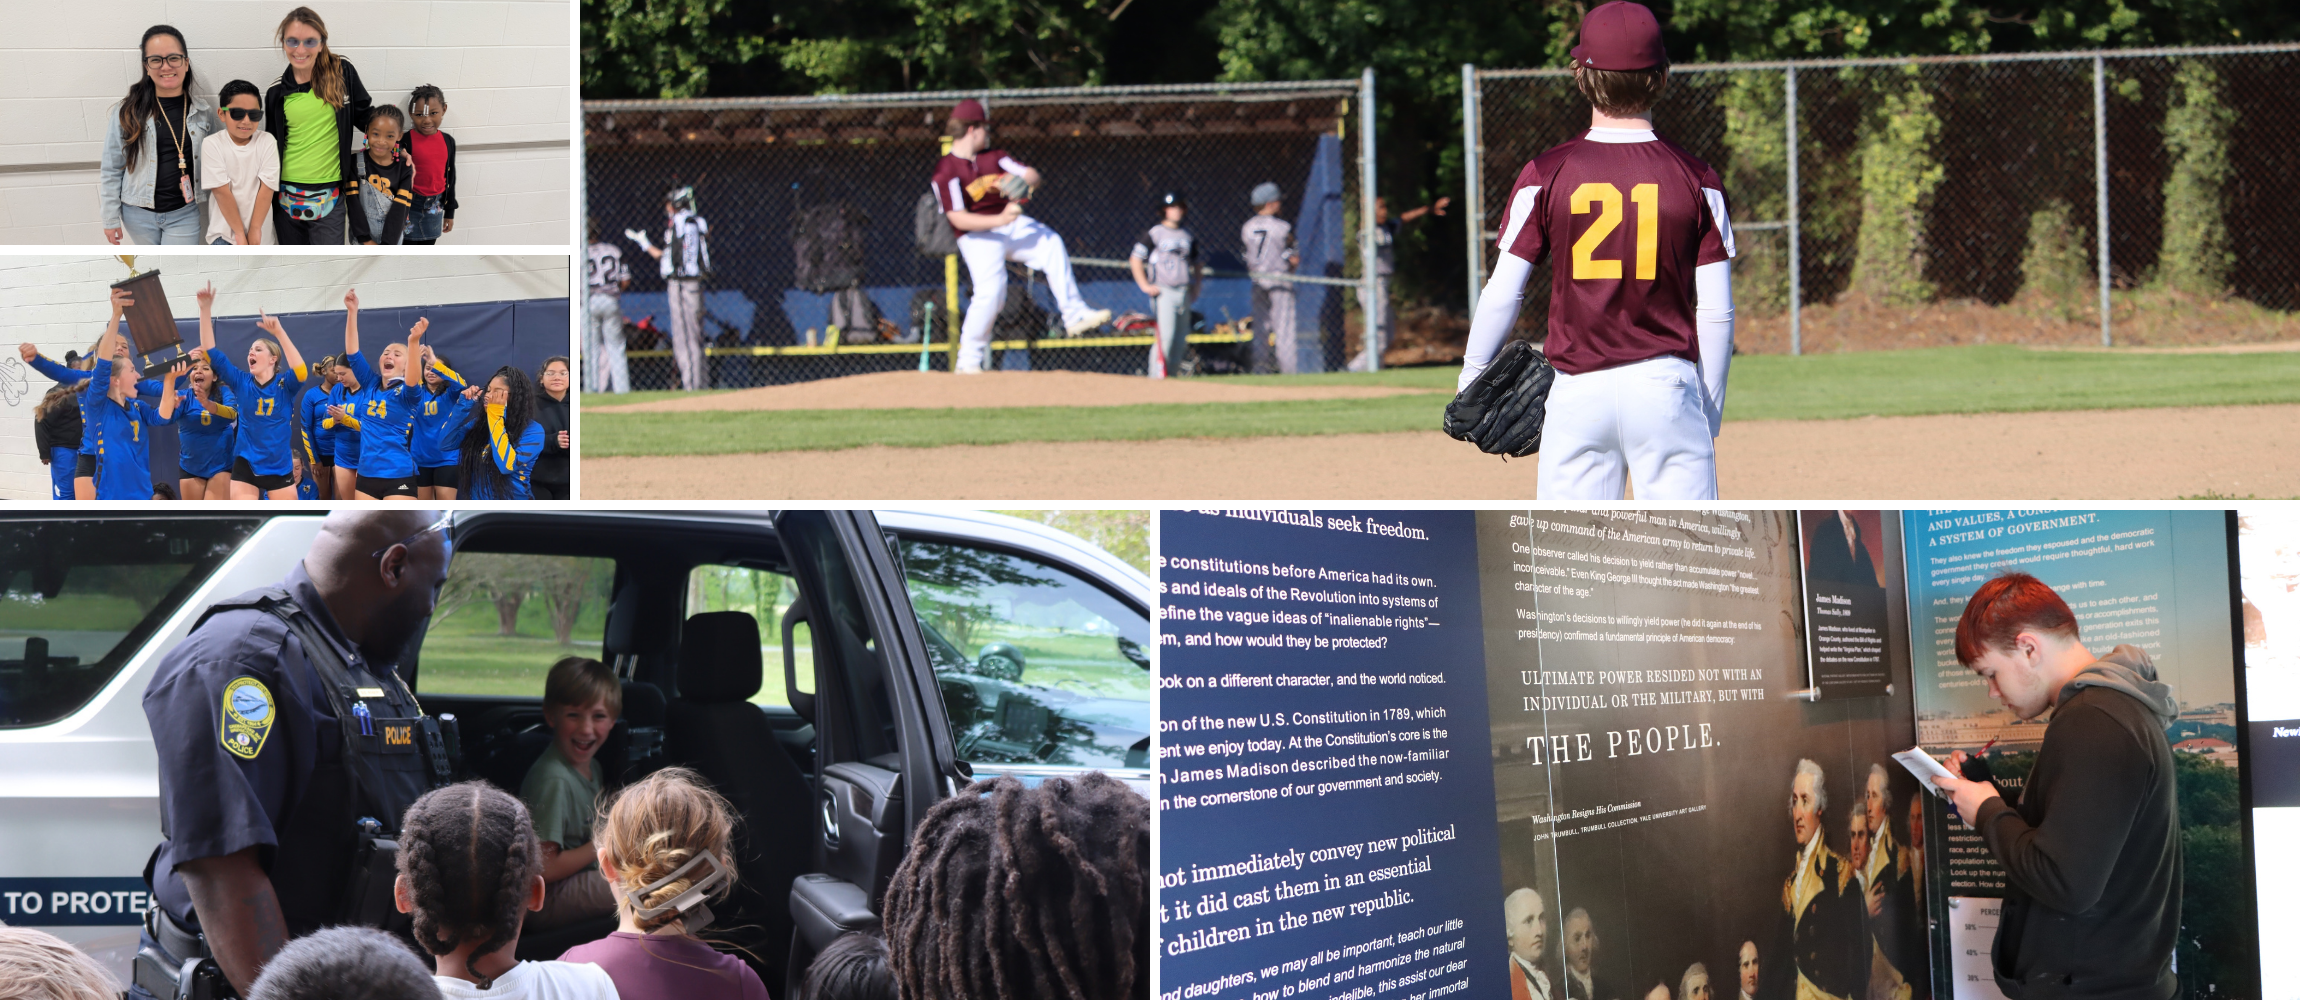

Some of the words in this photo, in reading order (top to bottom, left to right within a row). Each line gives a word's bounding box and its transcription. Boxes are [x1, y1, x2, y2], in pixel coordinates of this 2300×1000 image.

[1570, 183, 1658, 280] 21
[1253, 230, 1268, 260] 7
[255, 397, 275, 416] 17
[367, 399, 387, 419] 24
[424, 401, 438, 416] 10
[130, 420, 140, 442] 7
[1328, 515, 1363, 533] seek
[1366, 517, 1429, 540] freedom.
[1928, 519, 1952, 532] AND
[1954, 511, 2004, 528] VALUES,
[2007, 510, 2015, 519] A
[1929, 537, 1937, 547] A
[1939, 530, 1985, 545] SYSTEM
[1988, 526, 2004, 538] OF
[2007, 512, 2100, 535] GOVERNMENT.
[1930, 557, 1947, 565] They
[1948, 555, 1963, 563] also
[1963, 552, 1982, 560] knew
[1982, 550, 1994, 558] the
[1995, 546, 2025, 556] freedom
[2026, 544, 2042, 552] they
[2043, 538, 2080, 550] espoused
[2080, 535, 2096, 544] and
[2096, 534, 2110, 542] the
[2110, 528, 2154, 540] democratic
[1170, 557, 1270, 576] constitutions
[1272, 563, 1316, 579] before
[1318, 567, 1370, 583] America
[1372, 571, 1393, 584] had
[1396, 573, 1409, 586] its
[1411, 577, 1437, 588] own.
[1171, 581, 1200, 596] and
[1204, 582, 1248, 598] ideals
[1250, 585, 1264, 599] of
[1266, 586, 1288, 600] the
[1290, 588, 1356, 604] Revolution
[1358, 592, 1380, 605] into
[1382, 595, 1426, 609] systems
[1428, 596, 1438, 608] of
[1199, 606, 1223, 622] the
[1226, 611, 1269, 626] vague
[1272, 610, 1308, 624] ideas
[1310, 612, 1322, 625] of
[1185, 632, 1212, 646] and
[1215, 632, 1243, 646] how
[1246, 634, 1283, 647] would
[1286, 634, 1312, 650] they
[1314, 635, 1329, 648] be
[1332, 636, 1388, 650] protected?
[1186, 676, 1204, 688] on
[1208, 676, 1217, 688] a
[1220, 673, 1274, 688] different
[1276, 673, 1334, 687] character,
[1336, 673, 1358, 686] and
[1360, 672, 1376, 685] the
[1378, 672, 1406, 684] world
[1408, 672, 1446, 684] noticed.
[1520, 670, 1595, 686] ULTIMATE
[1599, 670, 1643, 684] POWER
[1646, 669, 1695, 683] RESIDED
[1698, 668, 1720, 681] NOT
[1722, 668, 1748, 680] WITH
[1750, 668, 1762, 680] AN
[1523, 695, 1608, 712] INDIVIDUAL
[1611, 694, 1628, 708] OR
[1631, 692, 1657, 706] THE
[1660, 690, 1716, 705] MILITARY,
[1718, 689, 1738, 702] BUT
[1740, 688, 1764, 700] WITH
[1182, 716, 1197, 731] of
[1200, 716, 1224, 730] the
[1228, 717, 1256, 728] new
[1260, 712, 1290, 727] U.S.
[1292, 710, 1368, 725] Constitution
[1370, 709, 1380, 721] in
[1383, 708, 1414, 720] 1789,
[1415, 706, 1446, 719] which
[228, 738, 254, 755] POLICE
[385, 726, 412, 745] POLICE
[1184, 744, 1205, 756] we
[1208, 740, 1244, 757] enjoy
[1247, 738, 1286, 754] today.
[1288, 736, 1302, 749] At
[1304, 735, 1323, 748] the
[1398, 731, 1420, 742] core
[1422, 728, 1431, 740] is
[1432, 727, 1448, 739] the
[1526, 732, 1592, 766] THE
[1606, 723, 1720, 758] PEOPLE.
[1170, 768, 1224, 784] James
[1226, 762, 1288, 778] Madison
[1291, 754, 1356, 772] described
[1358, 754, 1378, 766] the
[1380, 748, 1450, 764] now-familiar
[1173, 794, 1197, 809] the
[1200, 788, 1278, 806] cornerstone
[1280, 783, 1293, 797] of
[1295, 784, 1315, 796] our
[1318, 775, 1382, 796] government
[1384, 772, 1404, 786] and
[1406, 770, 1442, 784] society.
[1191, 848, 1306, 883] immediately
[1310, 843, 1364, 863] convey
[1367, 838, 1398, 853] new
[1401, 824, 1456, 852] political
[1174, 900, 1192, 920] it
[1196, 891, 1229, 916] did
[1233, 886, 1271, 908] cast
[1274, 880, 1320, 900] them
[1324, 874, 1341, 891] in
[1345, 872, 1365, 887] an
[1368, 855, 1432, 882] essential
[4, 891, 43, 914] TO
[1167, 926, 1252, 956] children
[1255, 918, 1275, 936] in
[1278, 911, 1308, 931] the
[1312, 906, 1346, 924] new
[1349, 888, 1414, 916] republic.
[1184, 972, 1257, 999] daughters,
[1260, 965, 1279, 979] we
[1282, 958, 1308, 974] may
[1310, 950, 1324, 966] all
[1326, 949, 1340, 962] be
[1342, 934, 1395, 958] important,
[1398, 926, 1425, 944] teach
[1427, 924, 1444, 936] our
[1444, 918, 1464, 932] little
